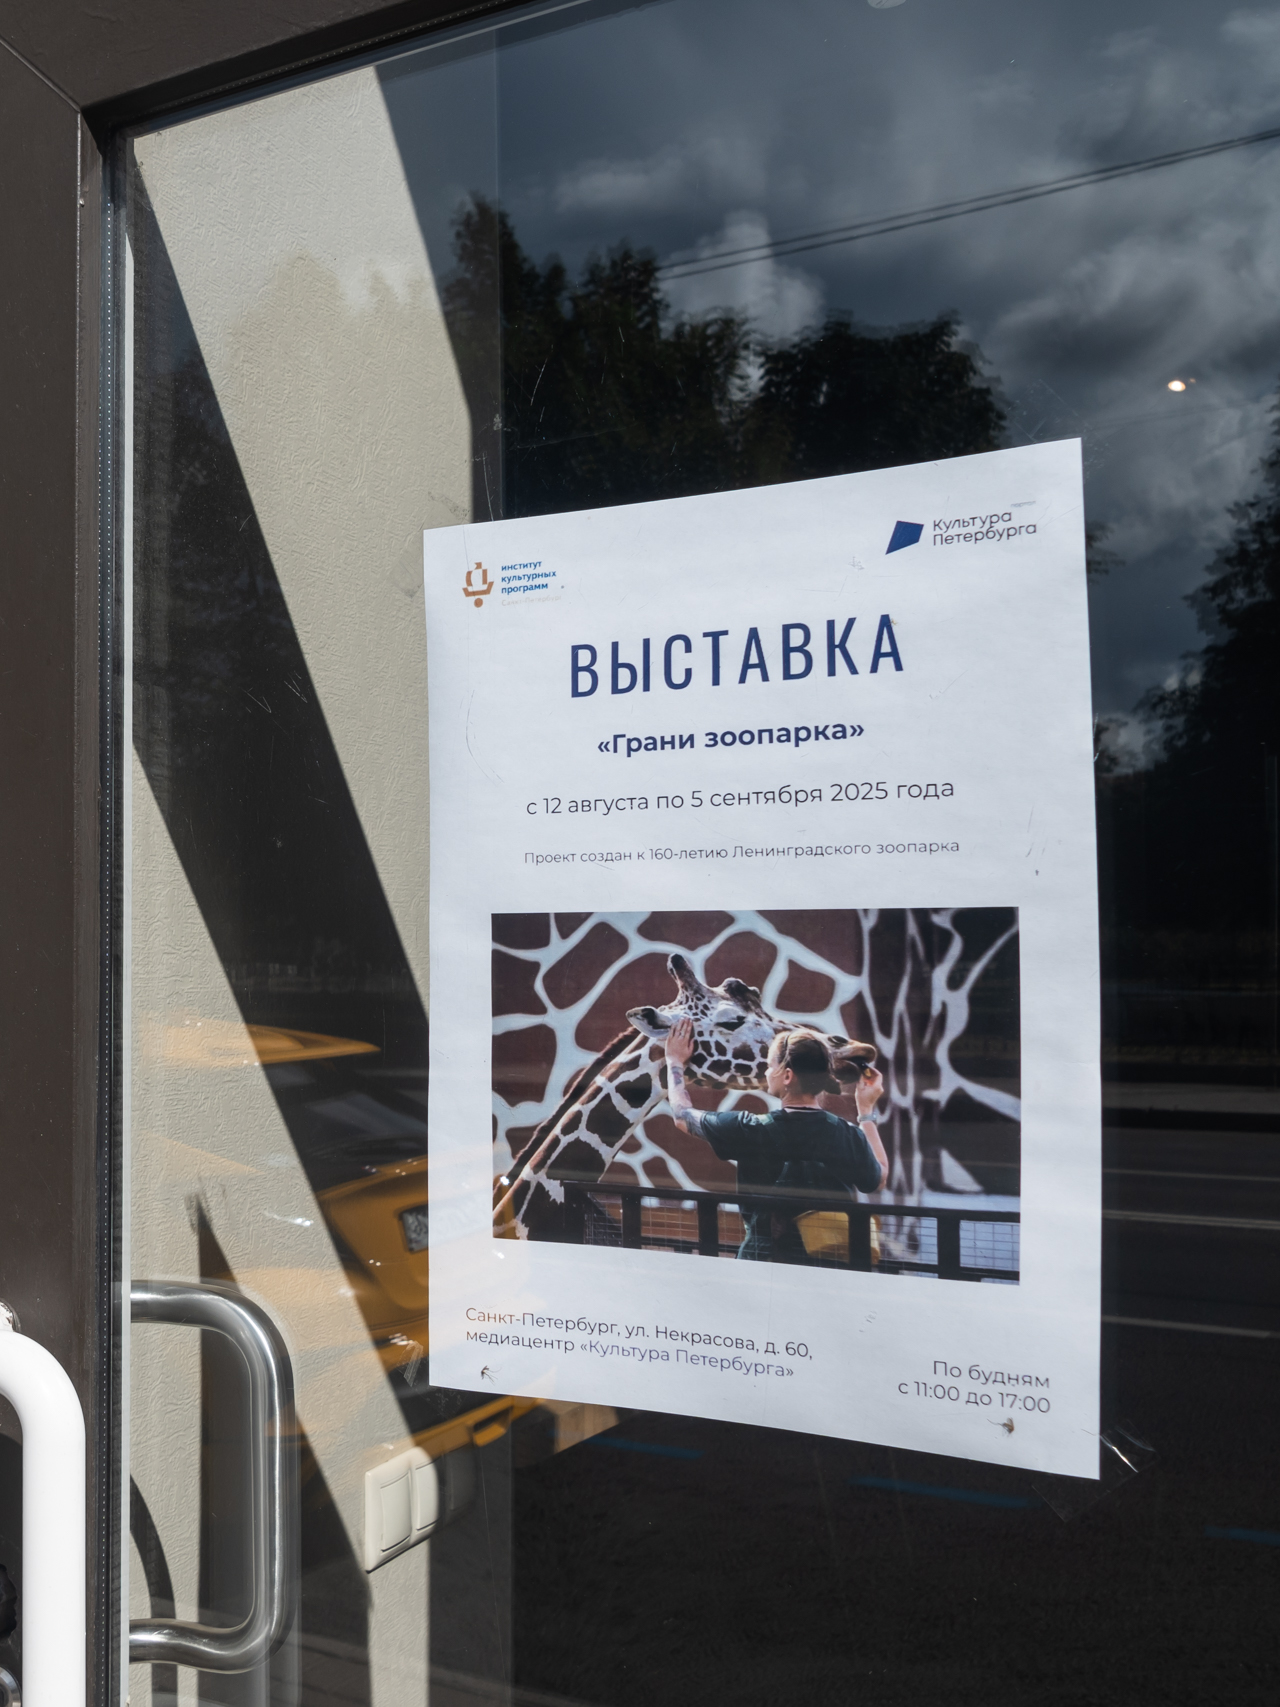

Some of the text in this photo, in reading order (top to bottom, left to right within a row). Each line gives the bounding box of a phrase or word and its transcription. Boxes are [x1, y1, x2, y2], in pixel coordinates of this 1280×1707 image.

[933, 512, 1012, 533] Культура
[933, 524, 1037, 546] Петербурга
[501, 561, 542, 572] институт
[501, 571, 557, 584] культурных
[501, 583, 549, 595] программ
[570, 613, 904, 698] ВЫСТАВКА
[597, 723, 865, 757] «Грани зоопарка»
[526, 781, 954, 815] с 12 августа по 5 сентября 2025 года
[524, 842, 959, 865] Проект создан к 160-летию Ленинградского зоопарка
[465, 1307, 813, 1360] Санкт-Петербург, ул. Некрасова, д. 60,
[466, 1331, 794, 1377] медиацентр «Культура Петербурга»
[933, 1360, 1050, 1388] По будням
[898, 1381, 1051, 1413] с 11:00 до 17:00
